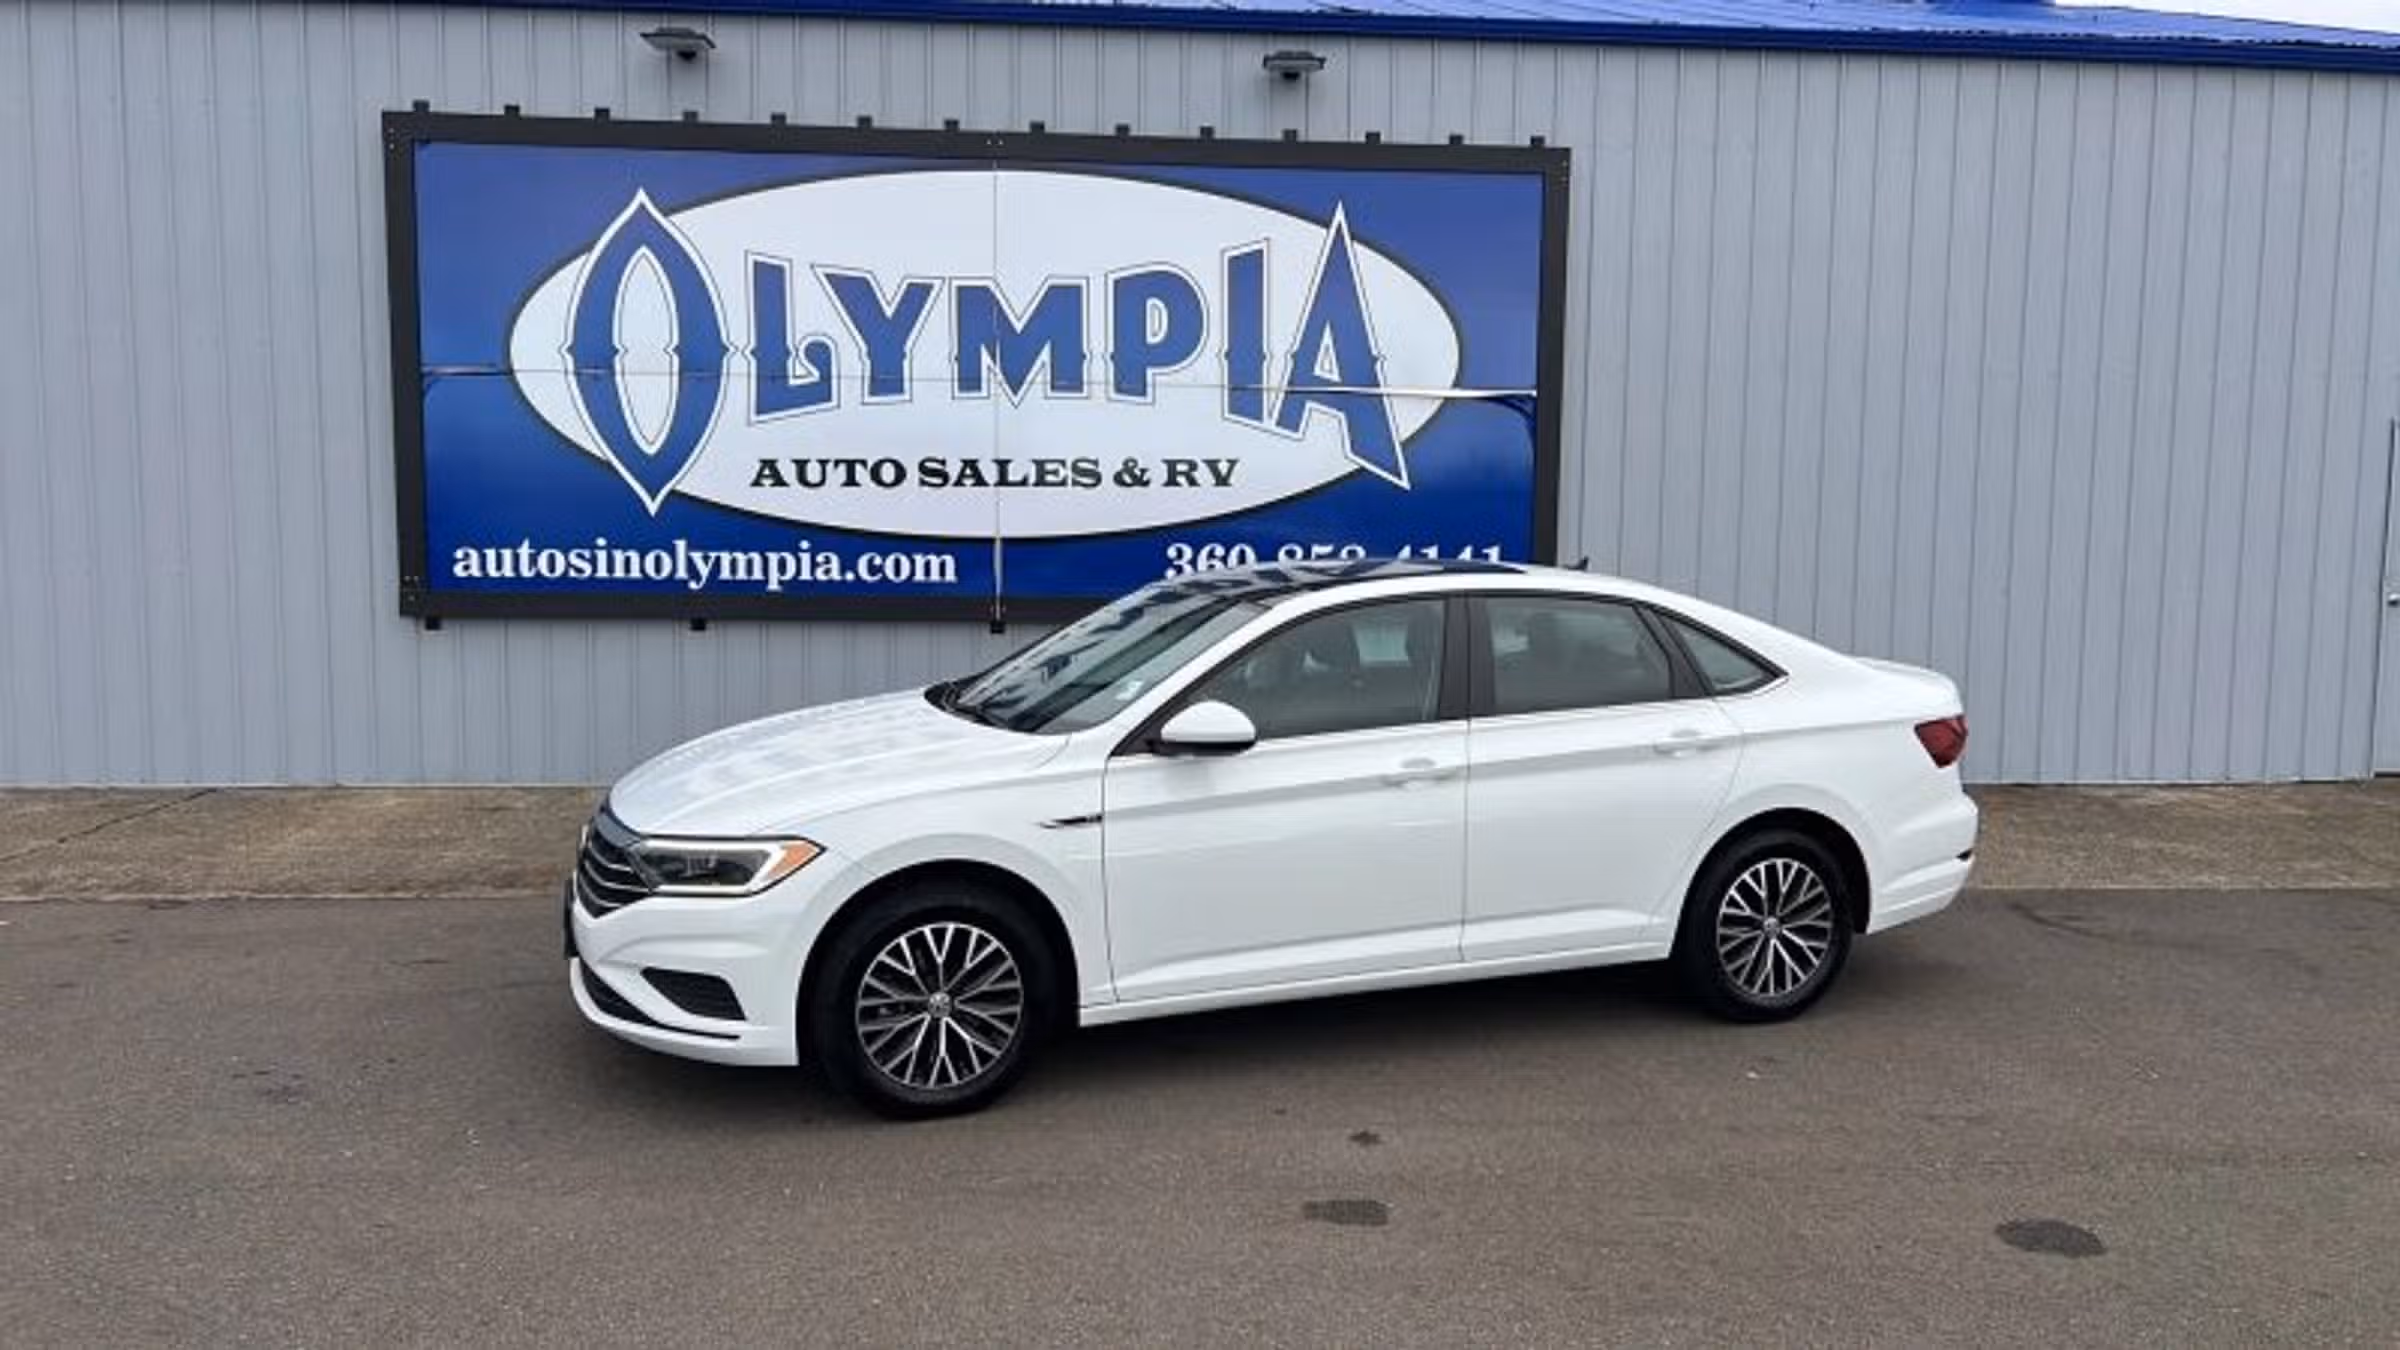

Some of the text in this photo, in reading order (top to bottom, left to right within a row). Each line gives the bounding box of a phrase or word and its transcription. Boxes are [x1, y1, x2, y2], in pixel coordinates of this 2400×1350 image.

[560, 188, 1410, 516] OLYMPIA
[750, 457, 1240, 488] AUTO SALES & RV
[452, 537, 957, 590] autosinolympia.com
